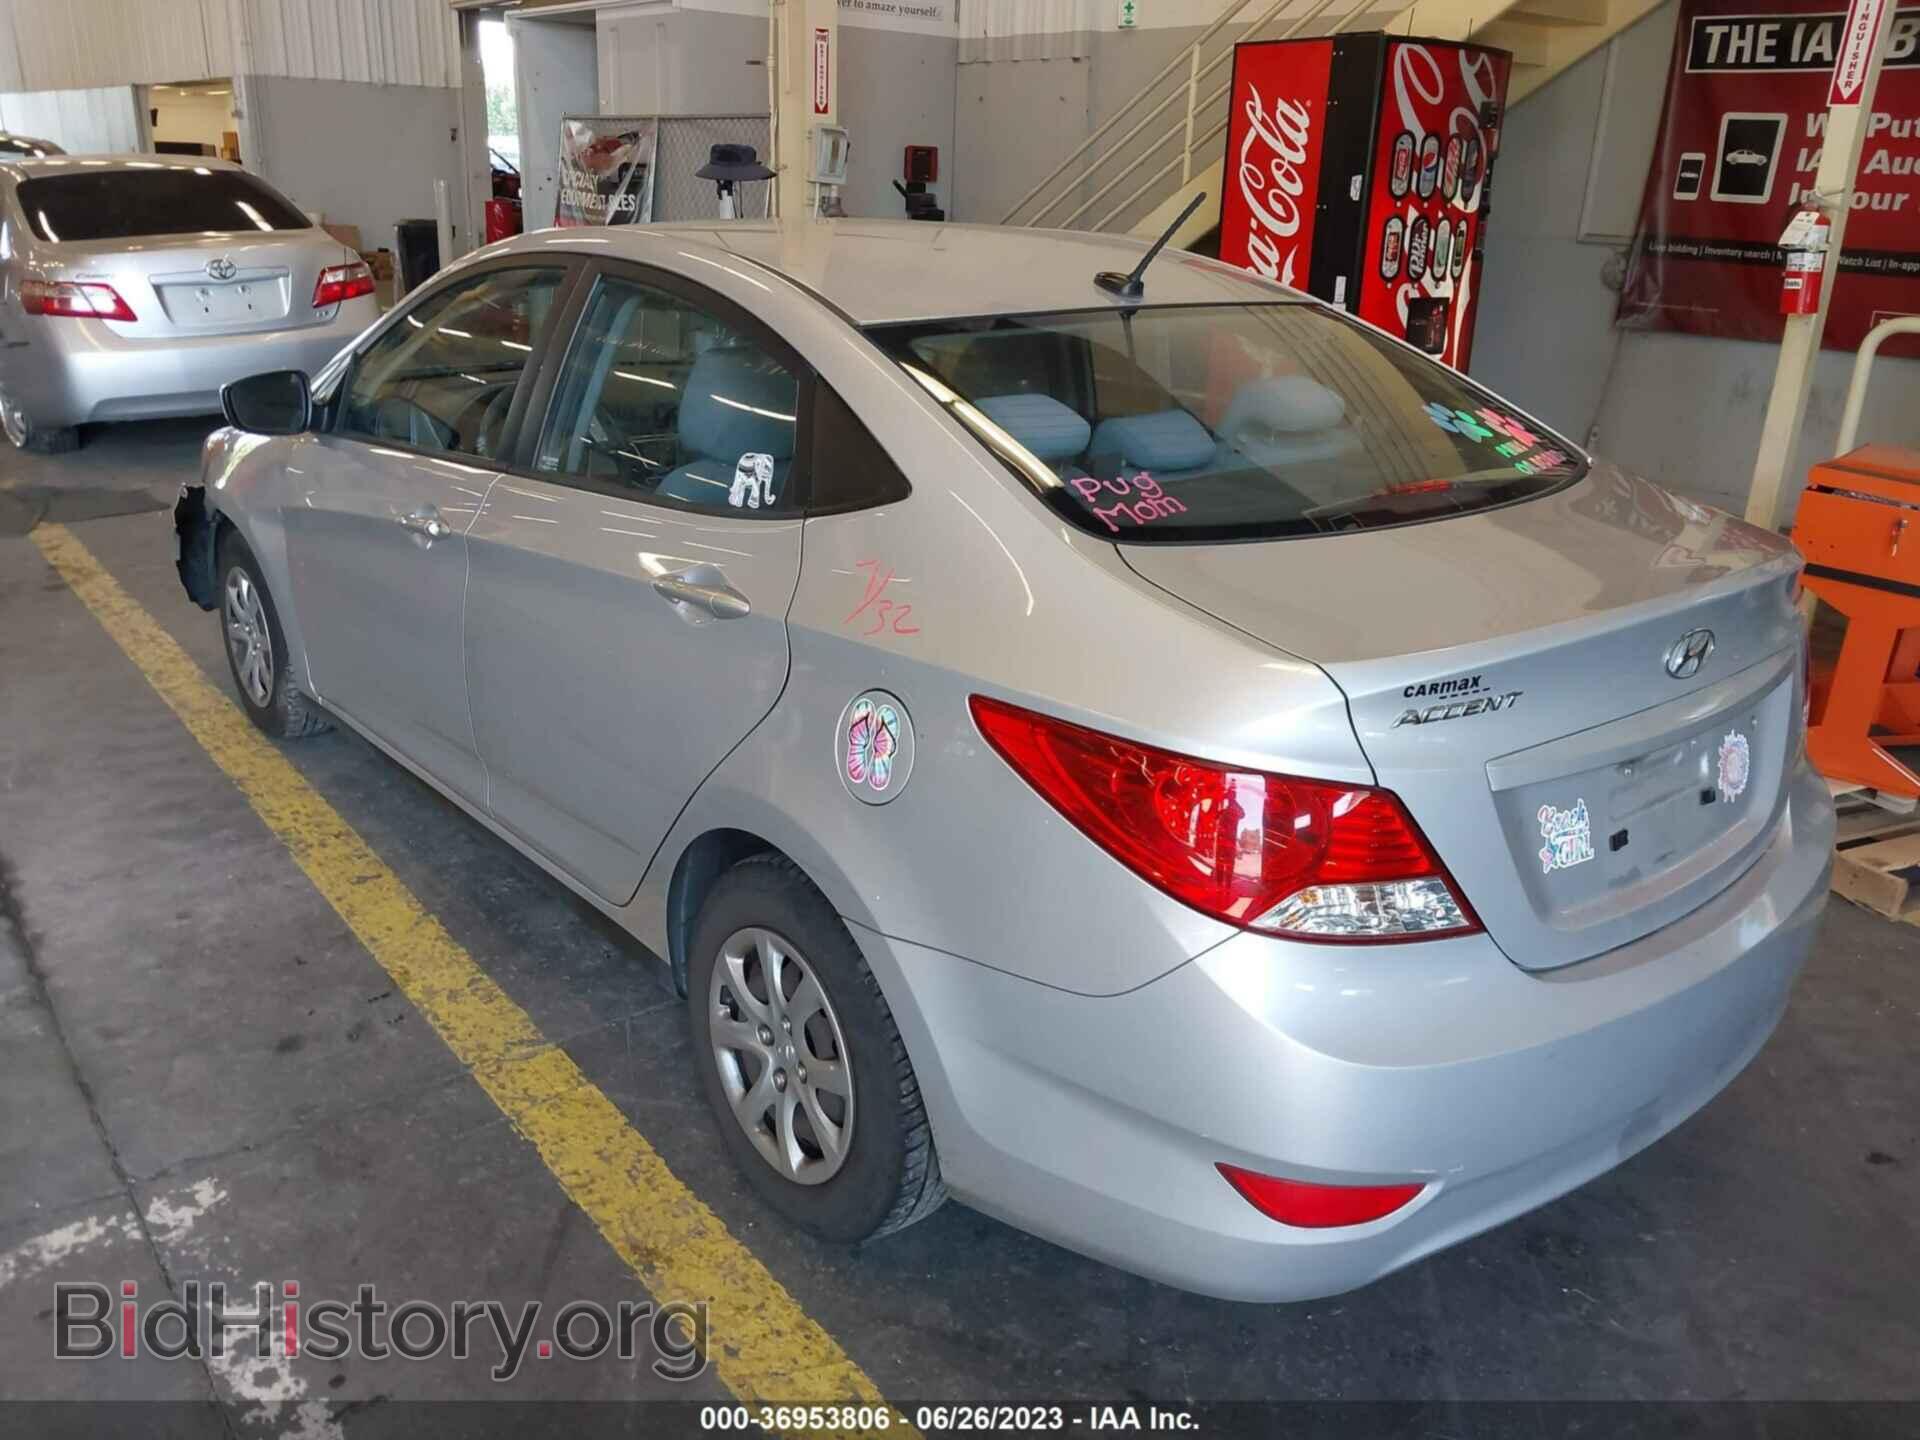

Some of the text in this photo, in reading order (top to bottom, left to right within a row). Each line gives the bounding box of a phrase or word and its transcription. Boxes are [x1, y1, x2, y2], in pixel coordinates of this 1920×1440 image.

[854, 0, 864, 9] to
[865, 2, 897, 13] amaze
[1705, 24, 1781, 64] THE
[1790, 22, 1836, 63] IA
[1806, 112, 1829, 138] W
[1796, 147, 1824, 172] IA
[1239, 81, 1310, 279] a-Cola
[1850, 191, 1911, 211] our
[1704, 246, 1742, 259] Inventory
[1070, 471, 1163, 503] Pug
[1092, 496, 1188, 532] Mom
[1391, 690, 1524, 729] ACCENT
